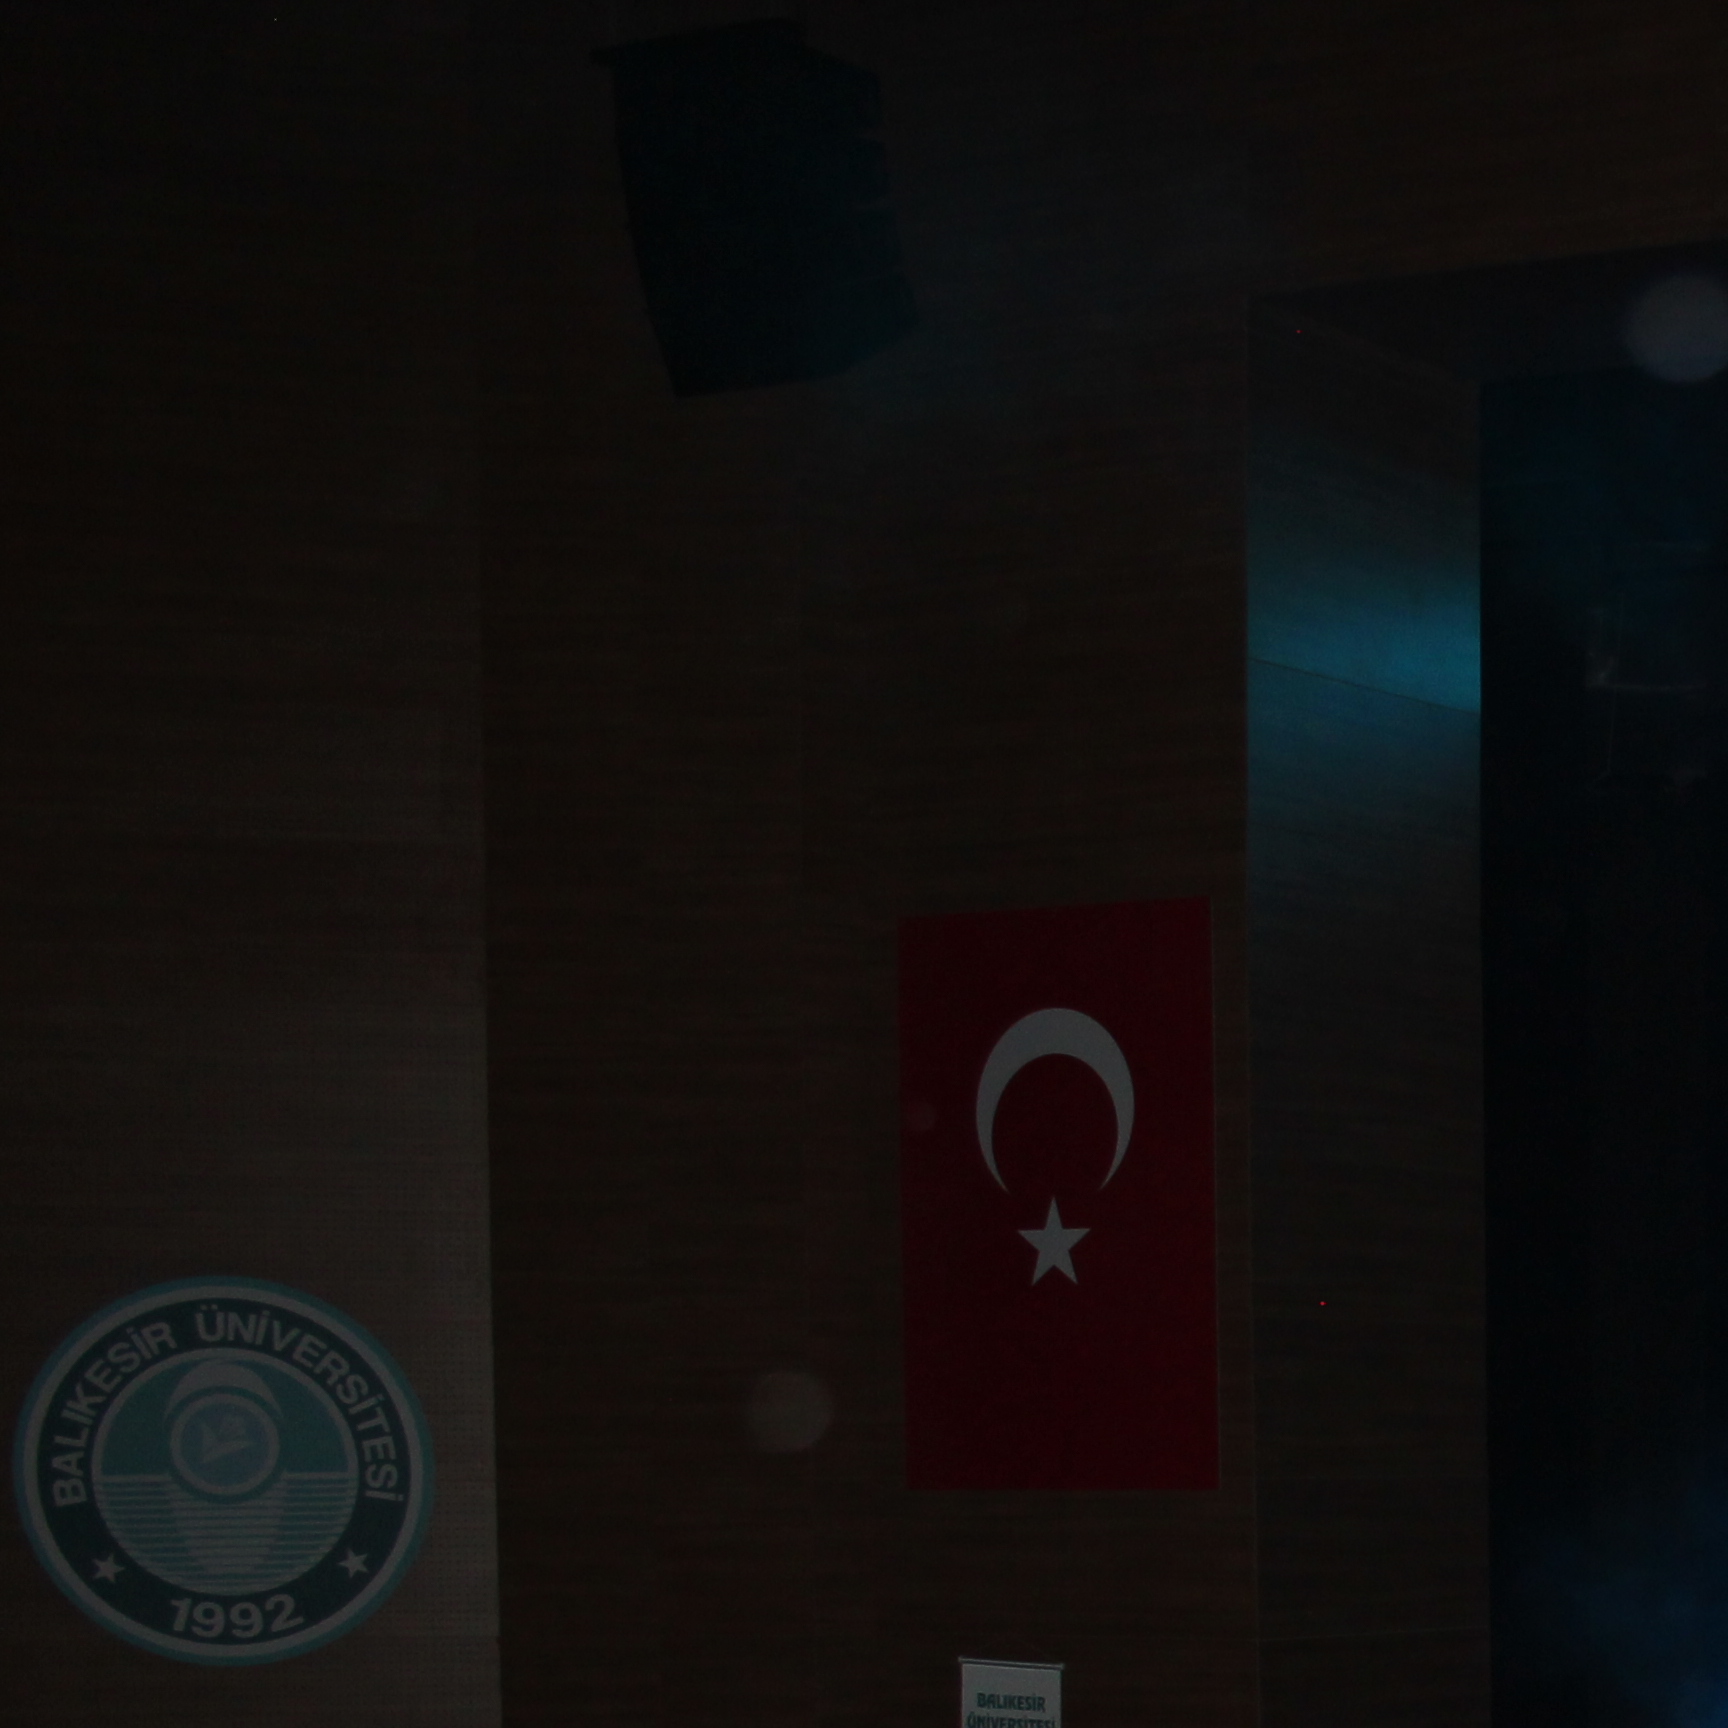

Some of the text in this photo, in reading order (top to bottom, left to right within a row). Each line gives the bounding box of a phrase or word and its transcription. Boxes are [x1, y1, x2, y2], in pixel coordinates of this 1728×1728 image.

[50, 1303, 406, 1508] BALIKESİR ÜNİVERSİTESİ
[169, 1593, 305, 1640] 1992
[976, 1692, 1046, 1713] BALIKESİR
